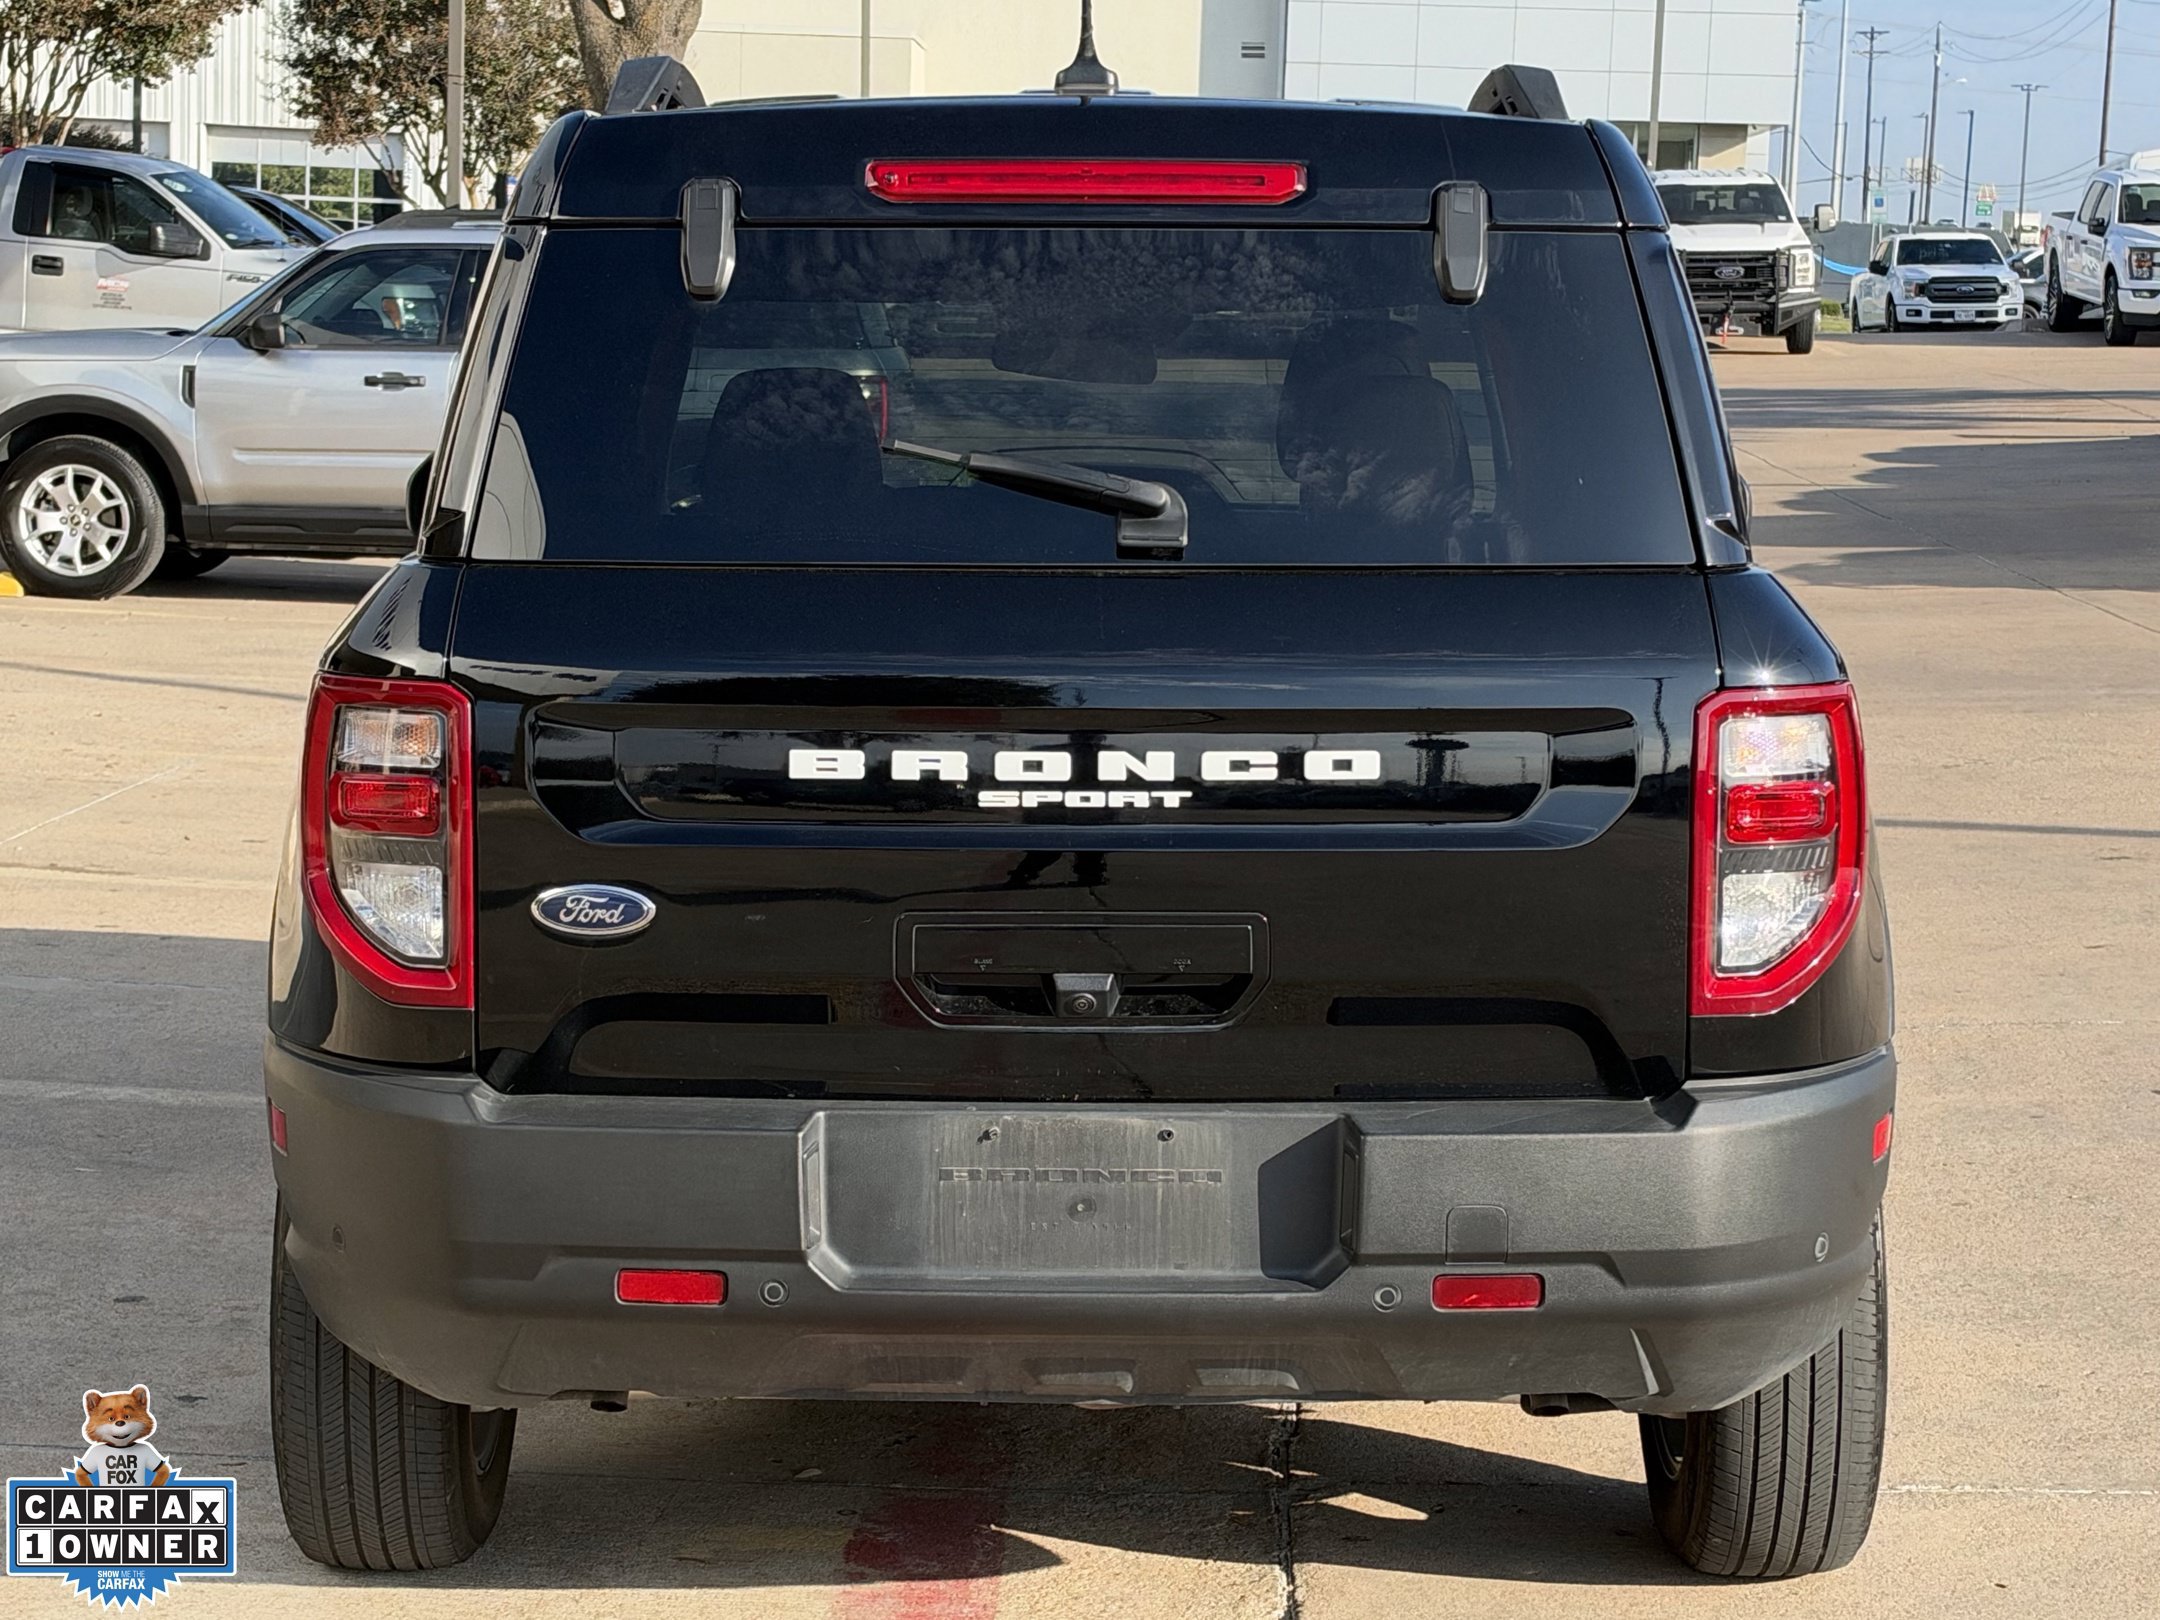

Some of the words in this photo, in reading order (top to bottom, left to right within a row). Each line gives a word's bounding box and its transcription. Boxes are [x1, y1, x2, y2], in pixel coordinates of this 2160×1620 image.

[788, 749, 1381, 782] BRONCO
[977, 791, 1193, 808] SPORT
[559, 895, 625, 923] Ford
[938, 1167, 1224, 1183] BRONCO
